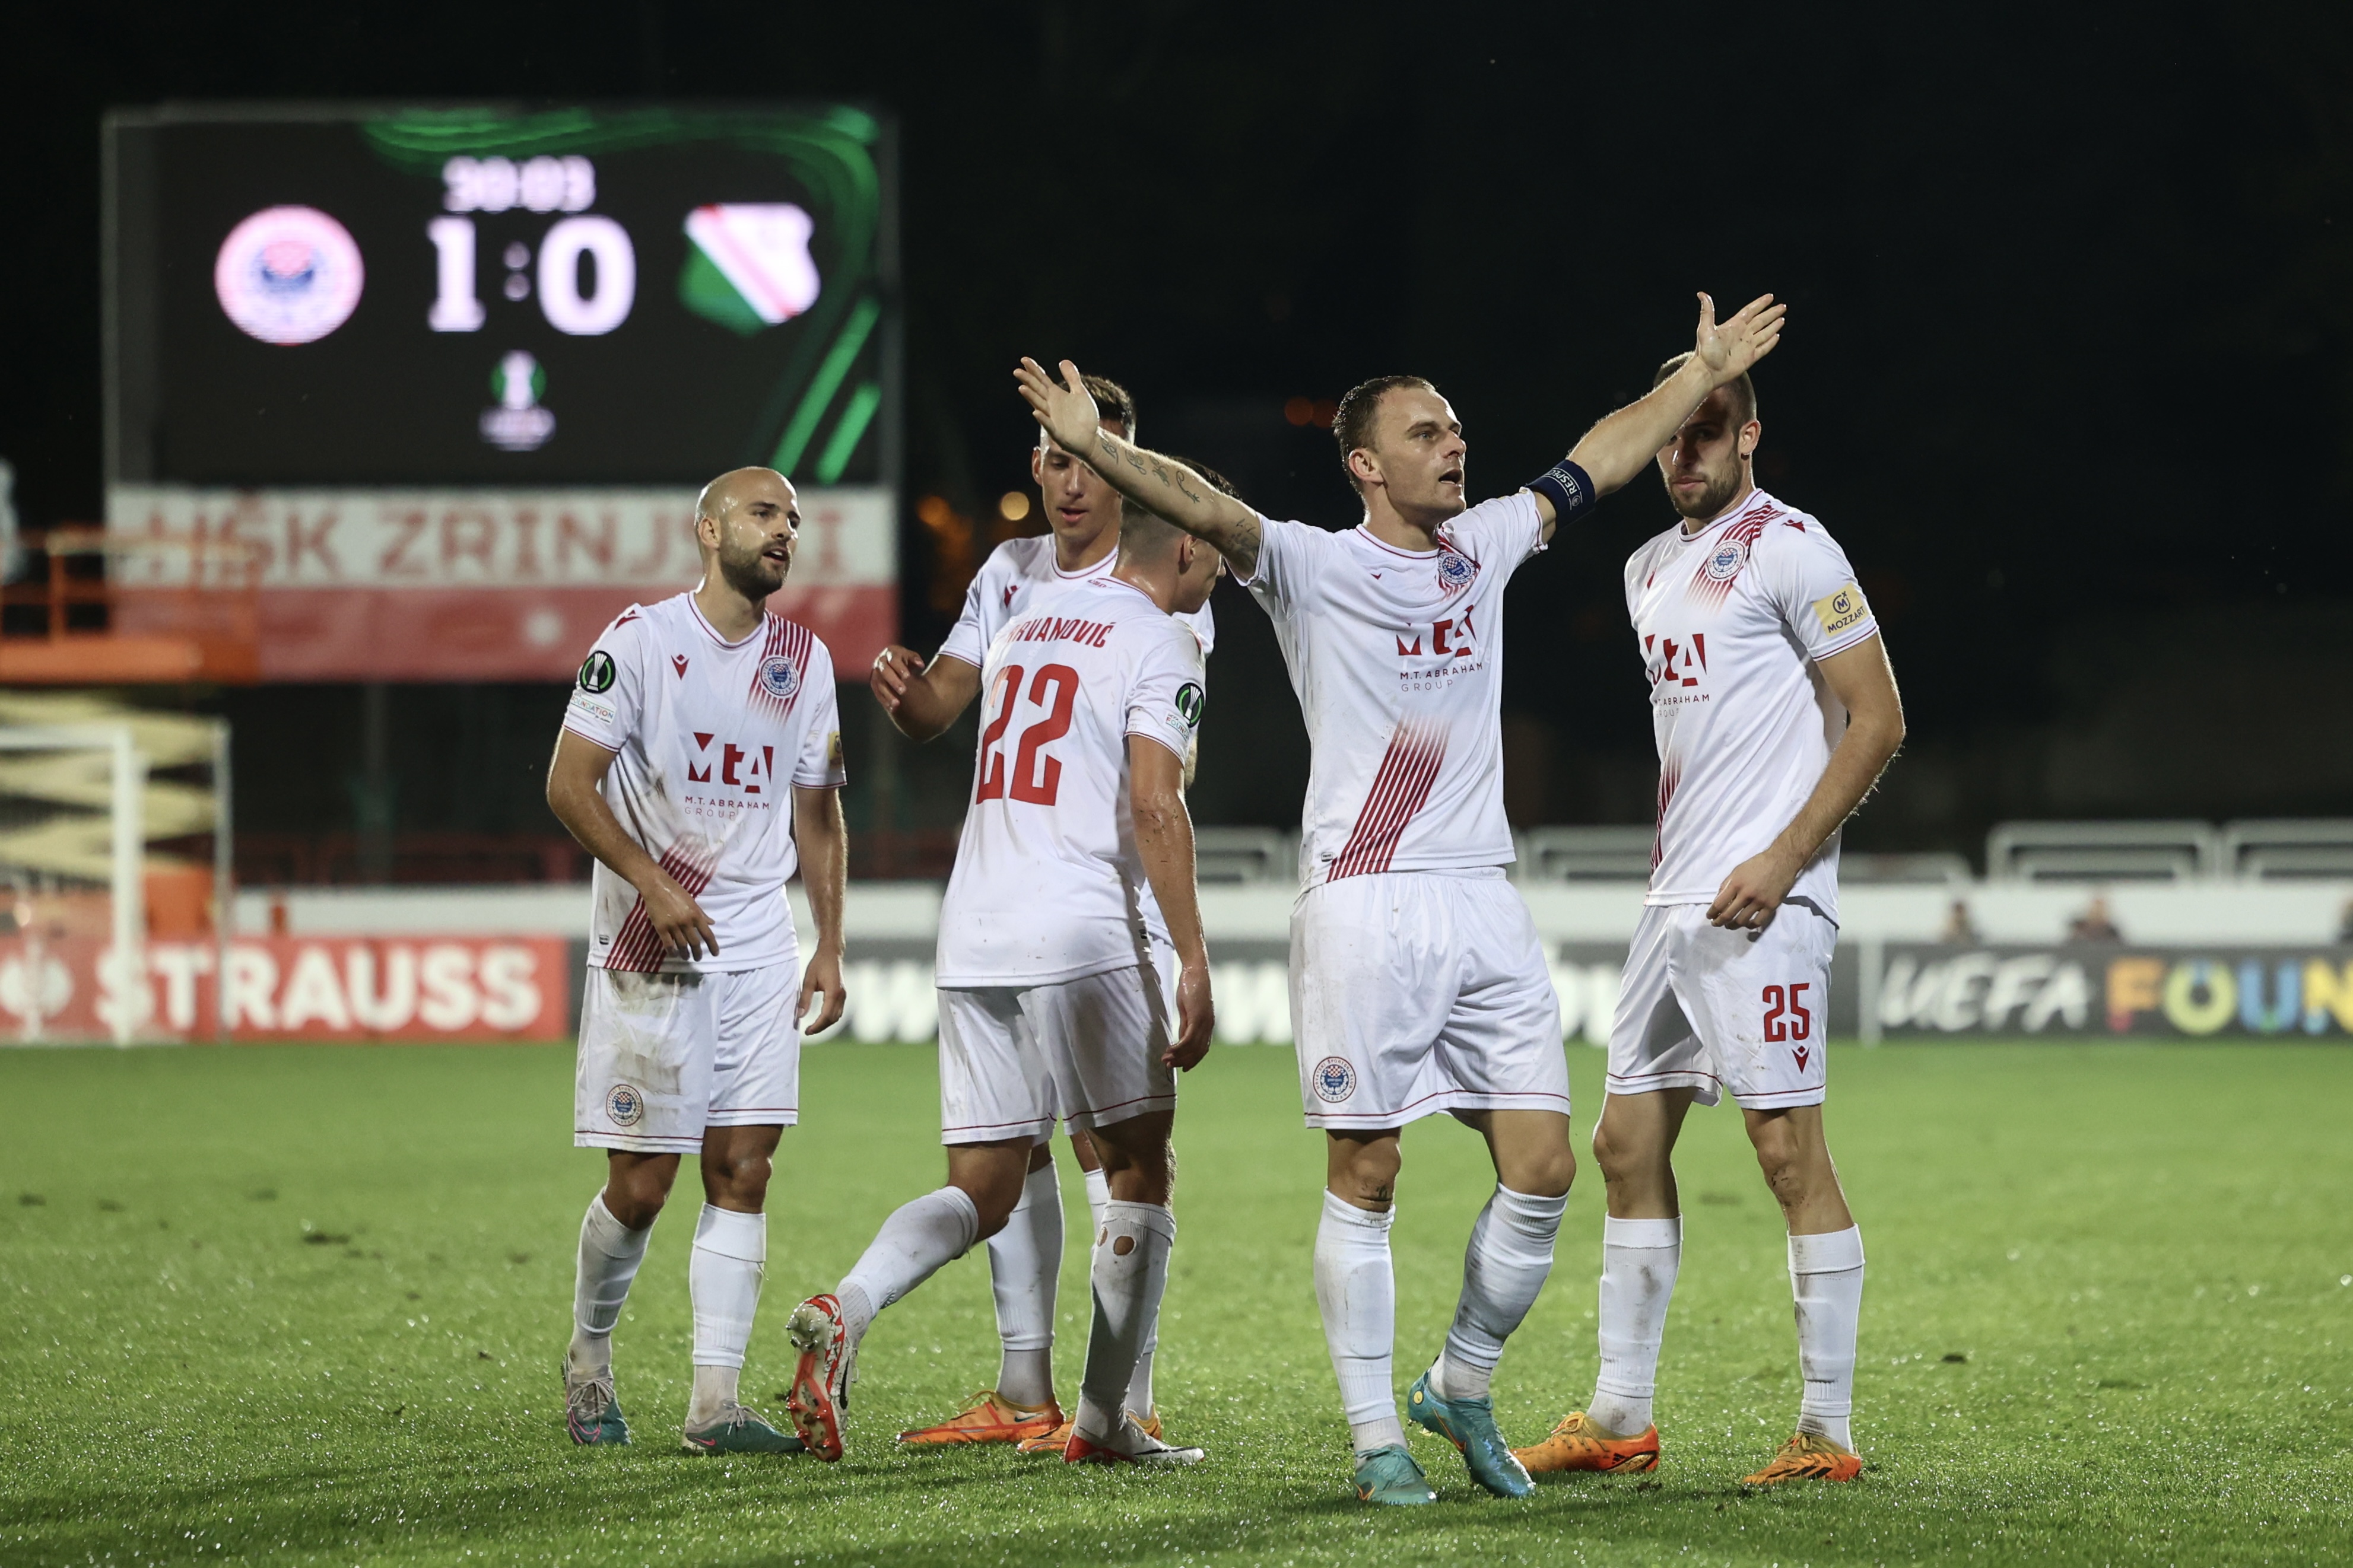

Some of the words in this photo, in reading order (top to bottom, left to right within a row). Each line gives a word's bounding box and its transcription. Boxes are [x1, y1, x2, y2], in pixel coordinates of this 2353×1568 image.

[1546, 469, 1577, 495] RESPEC
[377, 508, 840, 578] ZRINJI
[1827, 606, 1865, 633] MOZZART
[1425, 662, 1483, 678] ABRAHAM
[1401, 679, 1454, 692] GROUP
[1663, 694, 1710, 706] ABRAHAM
[976, 663, 1079, 806] 22
[685, 807, 736, 821] GROUP
[709, 799, 770, 810] ABRAHAM
[95, 945, 542, 1031] STRAUSS
[1878, 951, 2090, 1032] UEFA
[2107, 955, 2353, 1035] FOUN
[1762, 982, 1810, 1042] 25
